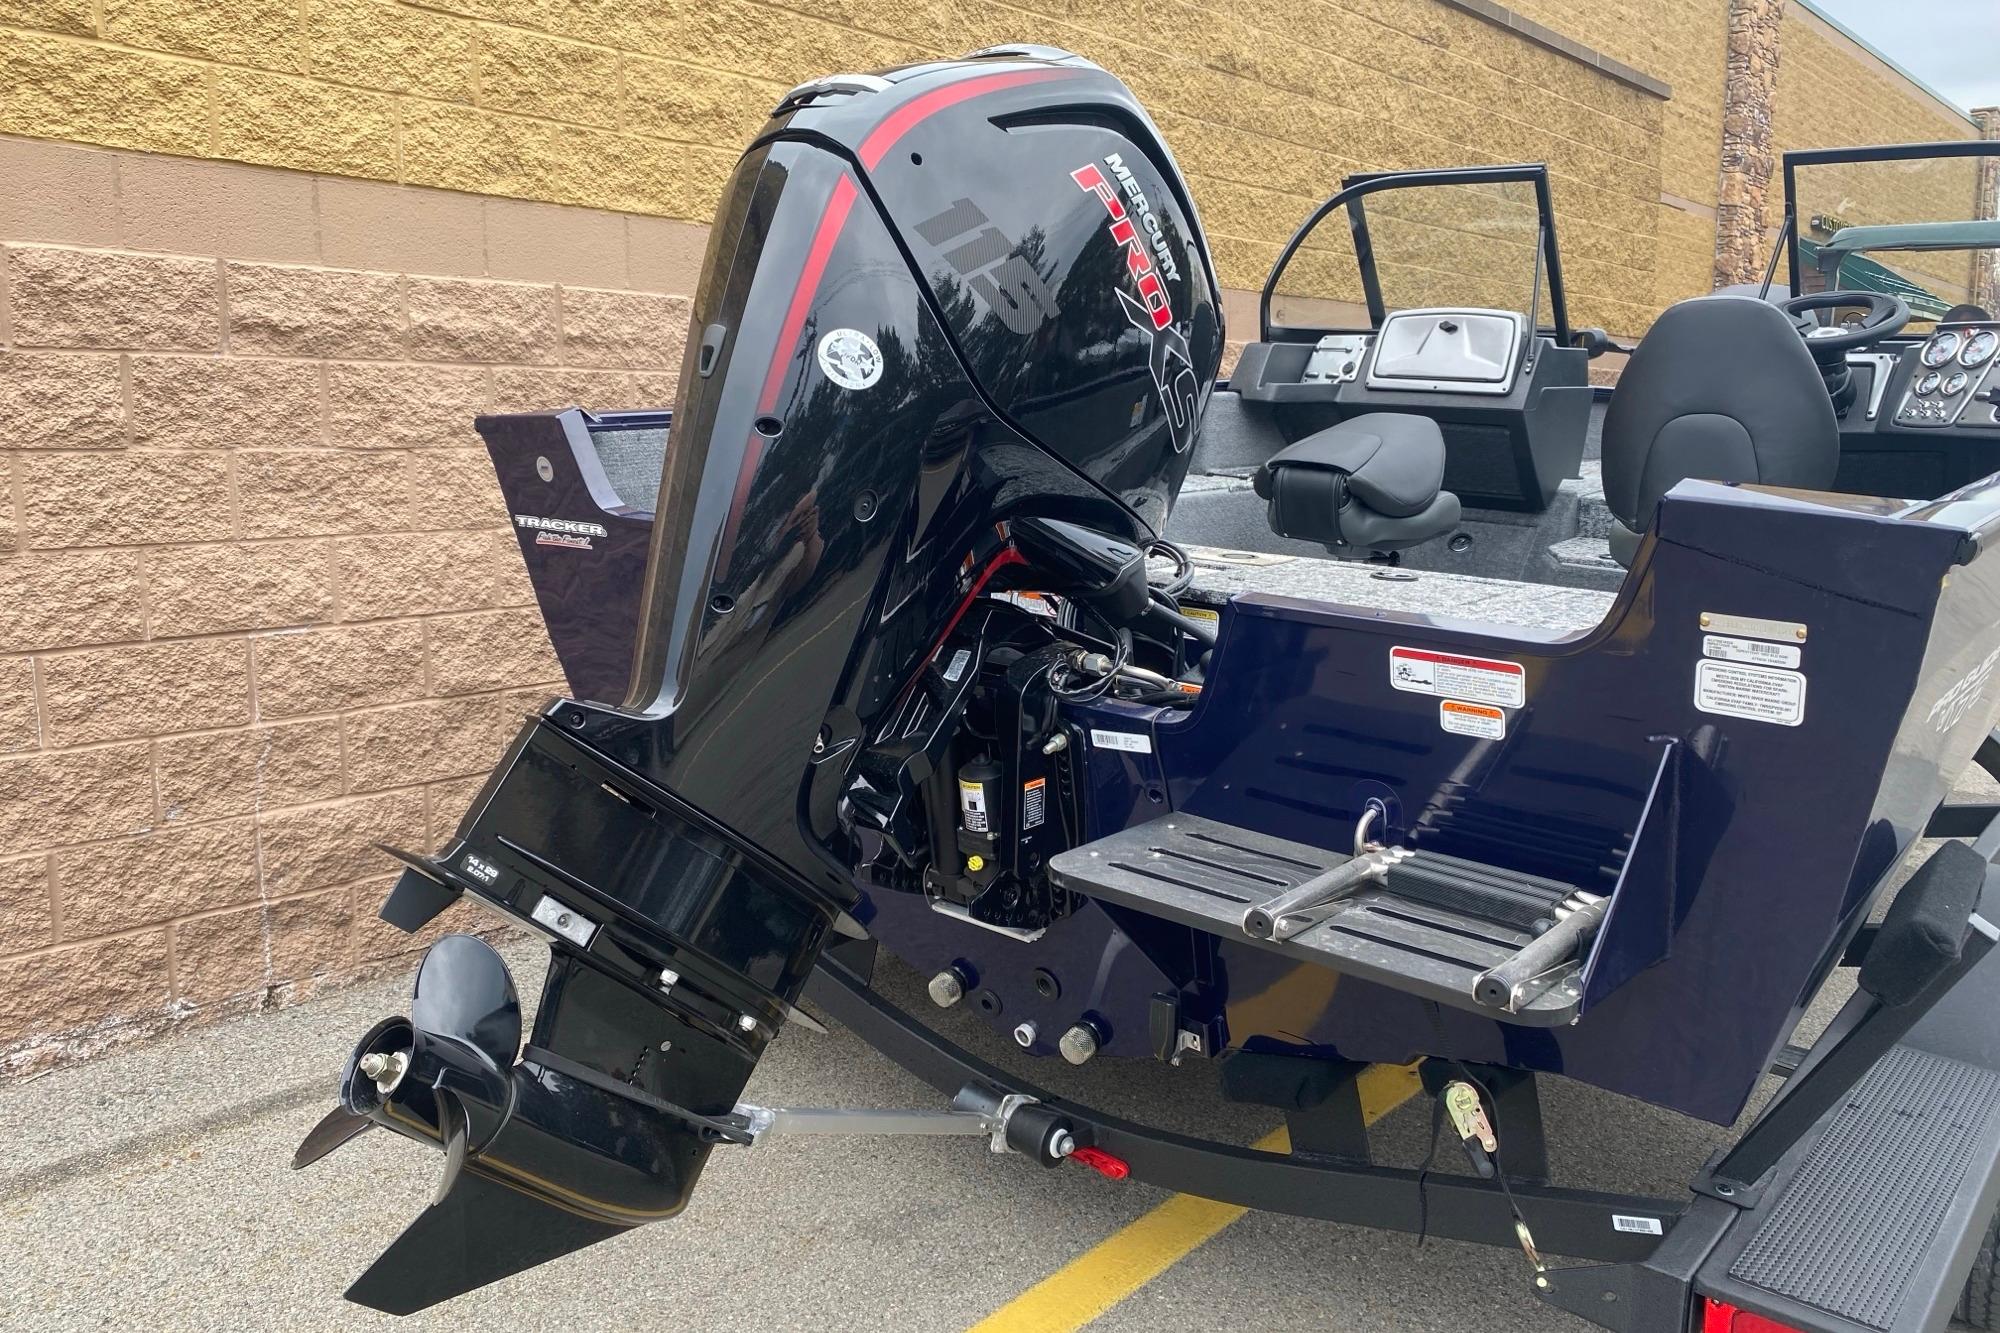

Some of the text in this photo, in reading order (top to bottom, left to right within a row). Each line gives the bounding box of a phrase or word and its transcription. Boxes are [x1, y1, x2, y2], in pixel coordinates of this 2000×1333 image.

[1103, 152, 1181, 283] MERCURY
[913, 197, 1061, 336] 115
[1070, 163, 1202, 454] PRO XS
[514, 514, 604, 537] TRACKER
[1441, 657, 1470, 665] DANGER
[1456, 705, 1488, 716] WARNING
[468, 855, 479, 866] 14
[484, 865, 498, 878] 29
